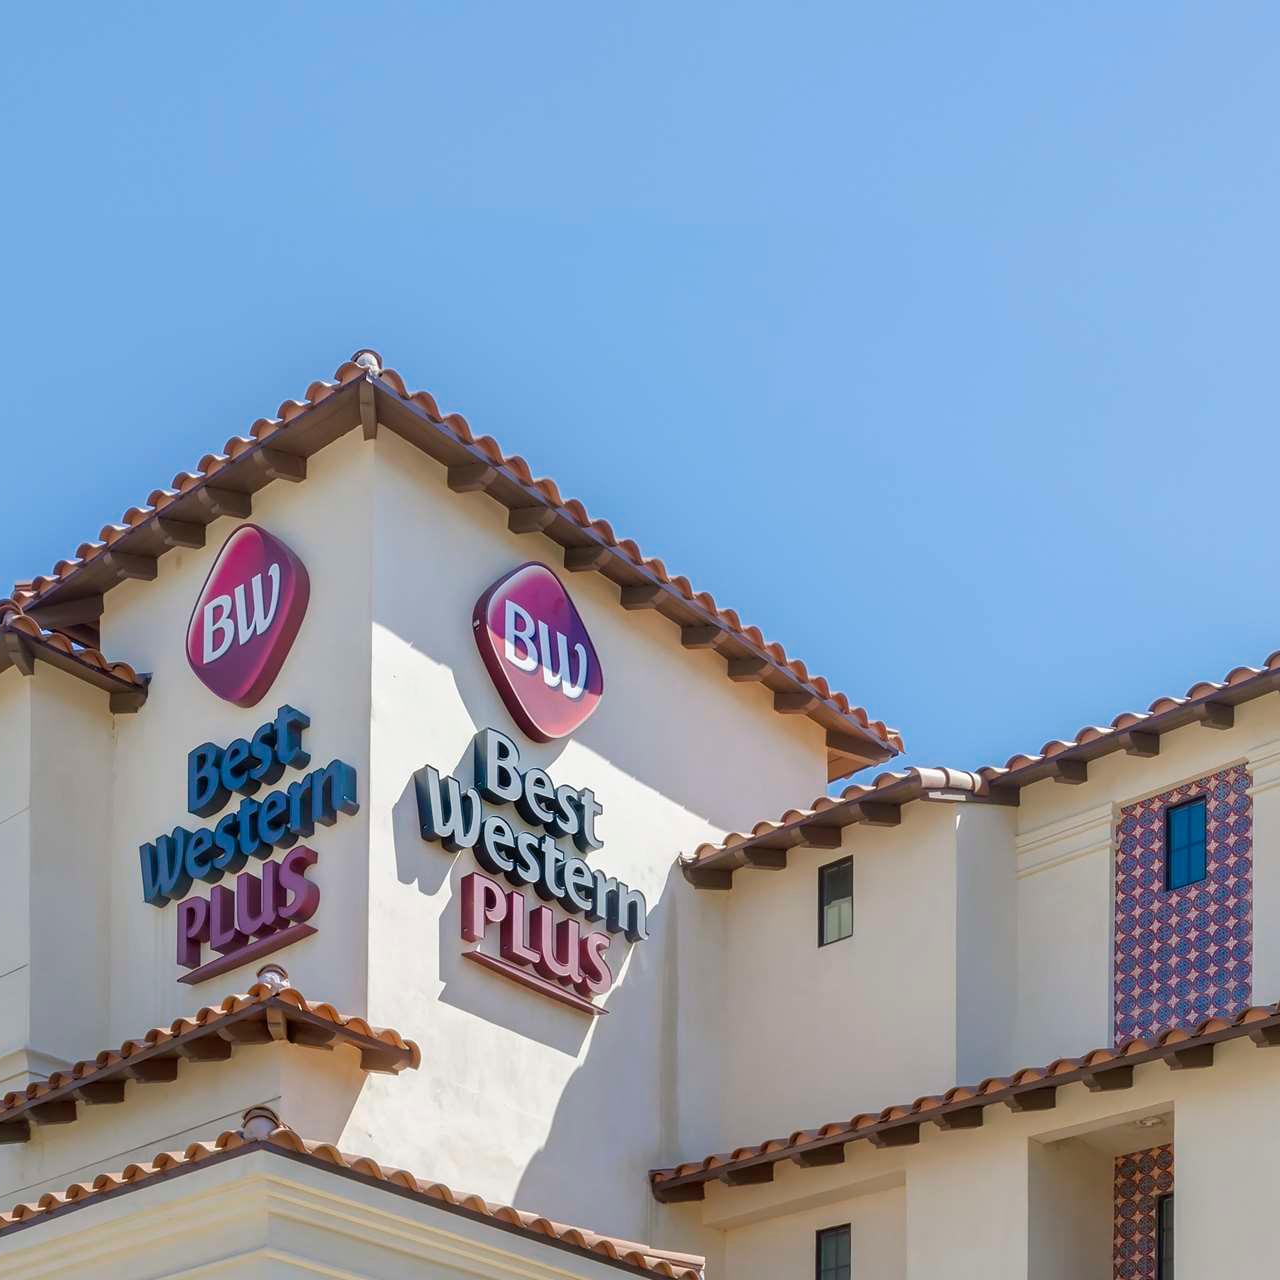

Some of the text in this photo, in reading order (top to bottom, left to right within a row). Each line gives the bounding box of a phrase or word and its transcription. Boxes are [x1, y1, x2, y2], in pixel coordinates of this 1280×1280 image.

[202, 563, 280, 664] BW
[504, 599, 588, 699] BW
[187, 704, 310, 818] Best
[474, 727, 604, 853] Best
[139, 759, 360, 908] Western
[413, 764, 649, 943] Western
[176, 845, 320, 968] PLUS
[460, 872, 612, 998] PLUS
